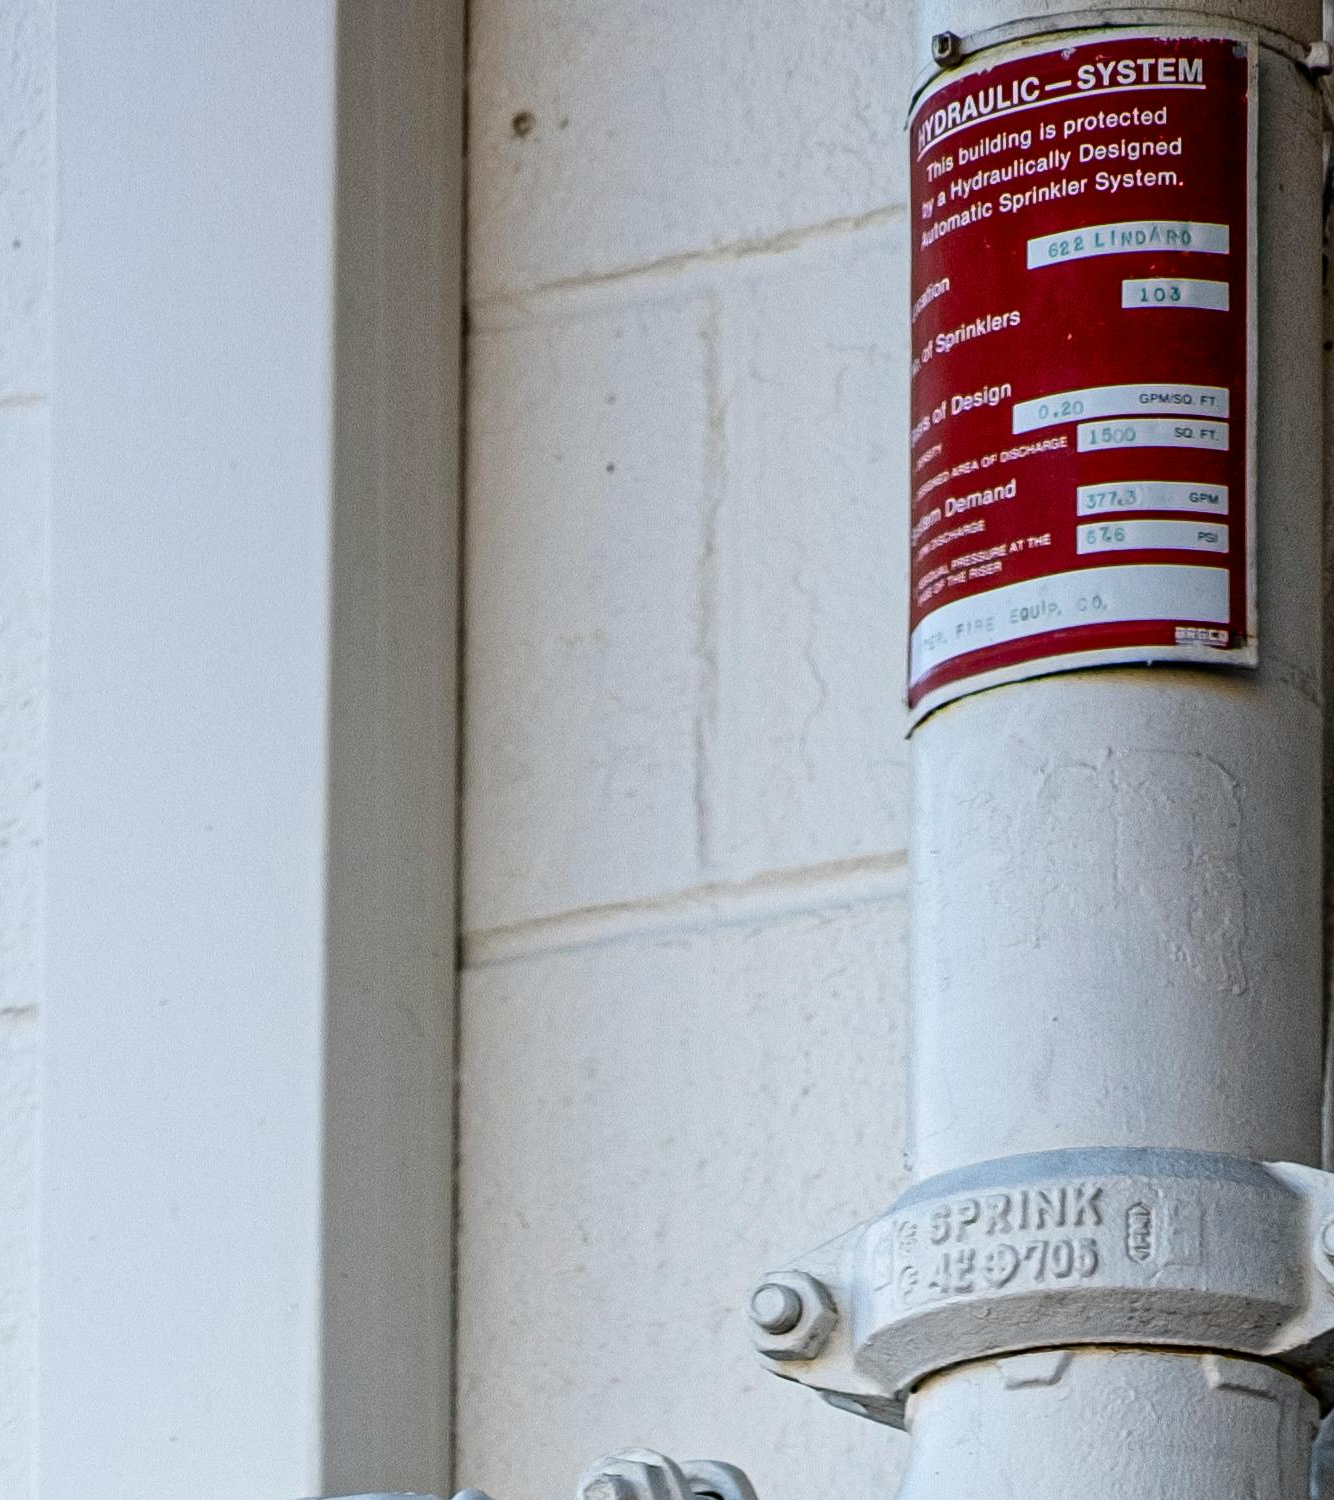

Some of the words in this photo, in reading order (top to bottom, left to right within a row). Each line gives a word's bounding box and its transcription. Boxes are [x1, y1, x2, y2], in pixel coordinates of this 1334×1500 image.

[918, 76, 1040, 148] HYDRAULIC
[1076, 57, 1204, 90] SYSTEM
[926, 155, 954, 183] This
[958, 129, 1032, 166] building
[1039, 121, 1056, 141] is
[1063, 105, 1168, 140] protected
[937, 190, 946, 207] a
[950, 148, 1072, 201] Hydraulically
[1078, 136, 1183, 162] Designed
[921, 200, 993, 248] Automatic
[998, 177, 1088, 214] Sprinkler
[1094, 168, 1185, 194] System.
[1048, 234, 1085, 259] 622
[1140, 286, 1182, 303] 103
[935, 309, 1021, 353] Sprinklers
[931, 399, 947, 425] of
[950, 382, 1012, 416] Design
[1037, 400, 1085, 420] 0.20
[980, 453, 998, 468] OF
[999, 435, 1068, 464] DISCHARGE
[1089, 426, 1137, 446] 1500
[944, 476, 1017, 518] Demand
[1025, 531, 1052, 549] THE
[929, 1184, 1104, 1248] SPRINK
